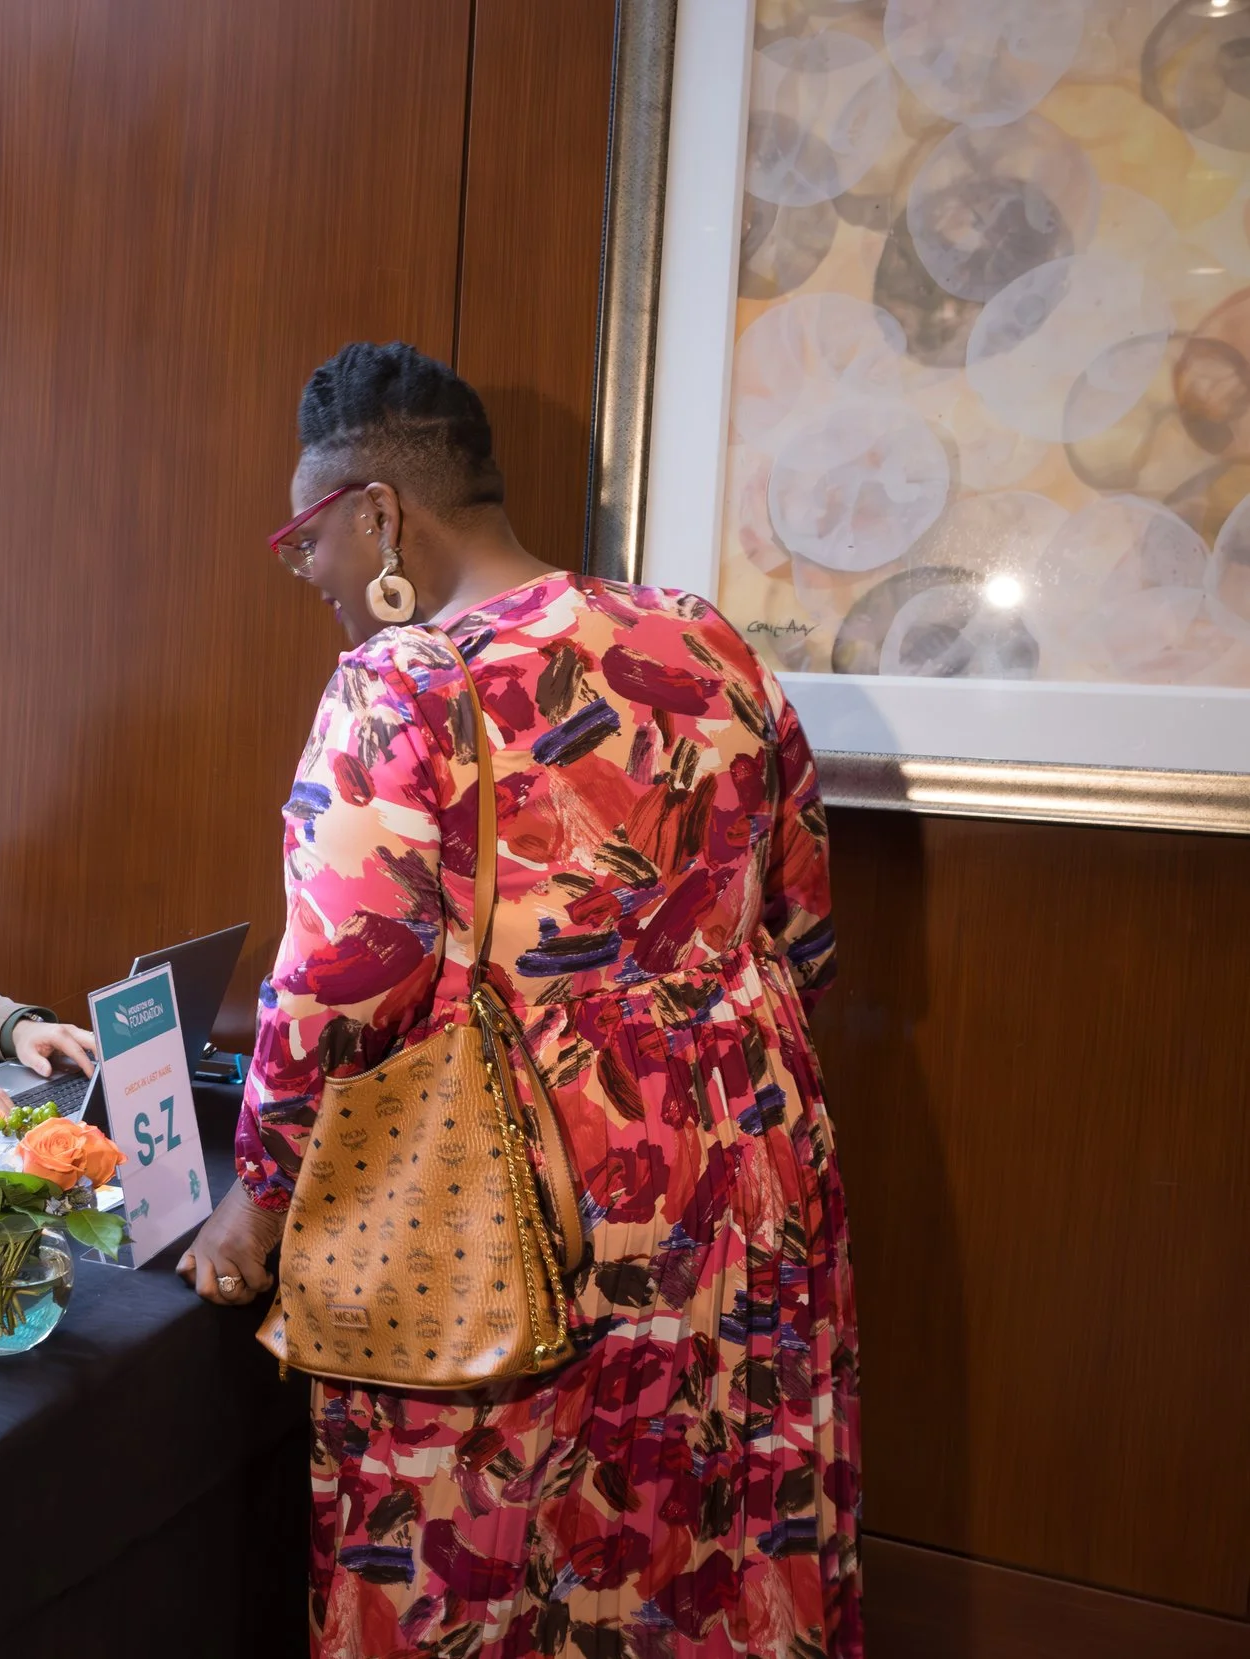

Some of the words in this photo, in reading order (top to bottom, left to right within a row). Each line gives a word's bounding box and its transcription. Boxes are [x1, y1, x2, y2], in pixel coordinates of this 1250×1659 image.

[129, 1003, 164, 1028] FOUNDATION
[134, 1094, 182, 1167] S-Z
[334, 1311, 363, 1323] MCM
